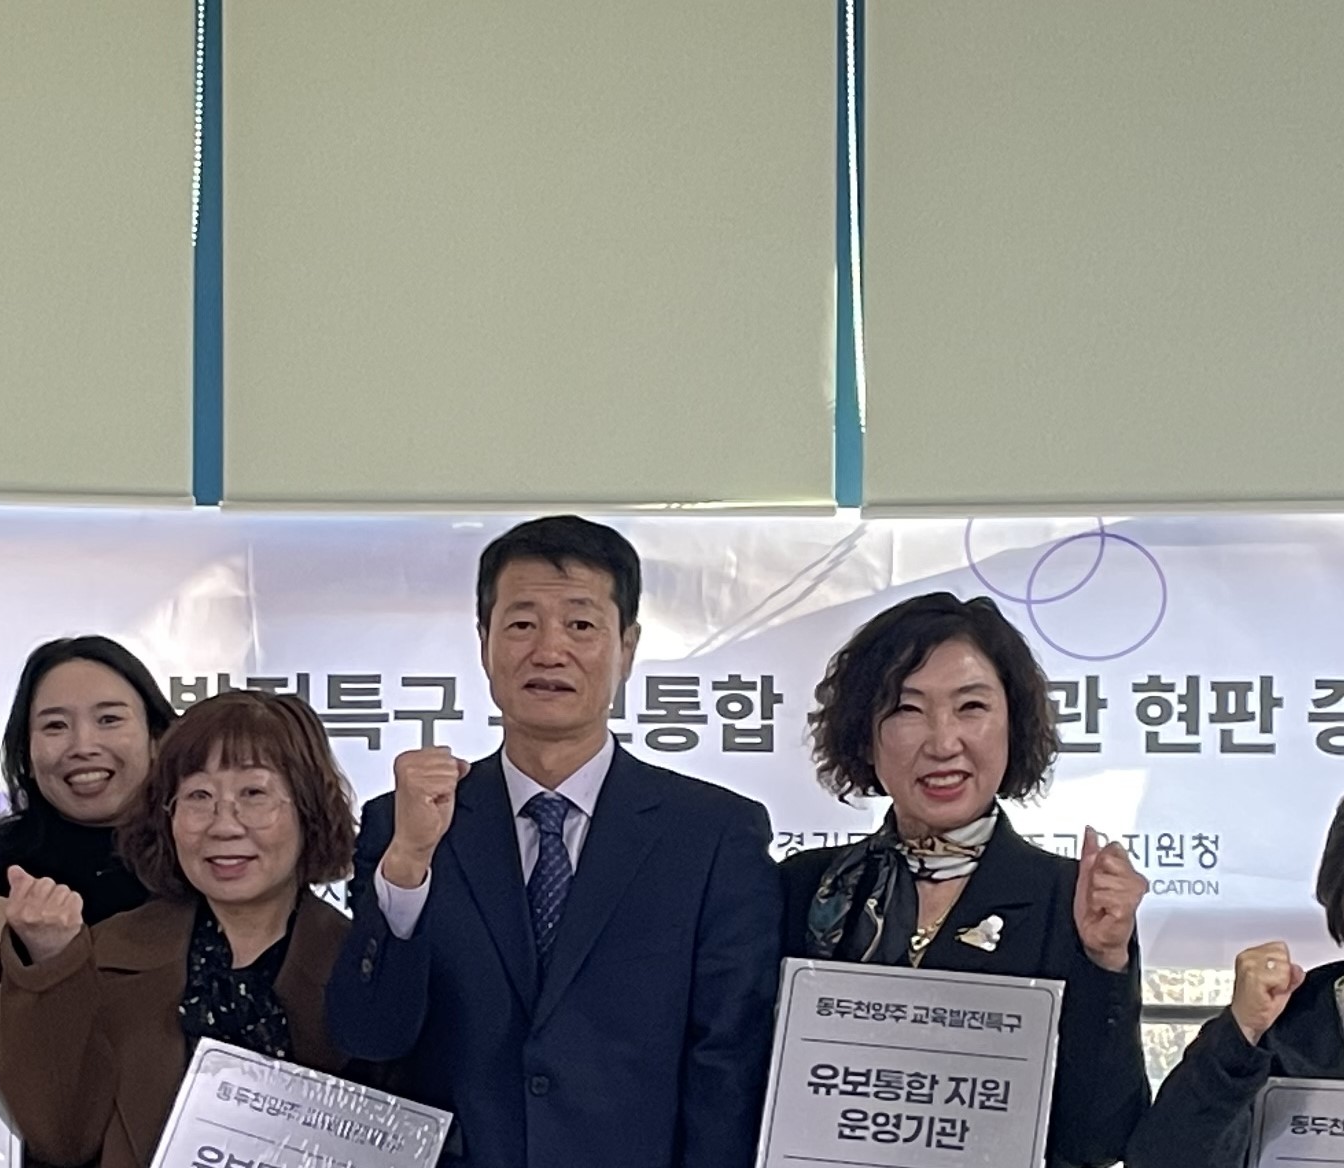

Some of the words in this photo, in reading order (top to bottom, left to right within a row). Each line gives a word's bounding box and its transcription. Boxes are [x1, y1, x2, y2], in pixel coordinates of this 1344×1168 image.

[1132, 674, 1283, 754] 현판
[816, 997, 907, 1023] 동두천양주
[911, 1005, 1022, 1033] 교육발전특구
[807, 1063, 939, 1104] 유보통합
[944, 1076, 1011, 1112] 지원
[837, 1108, 969, 1151] 운영기관
